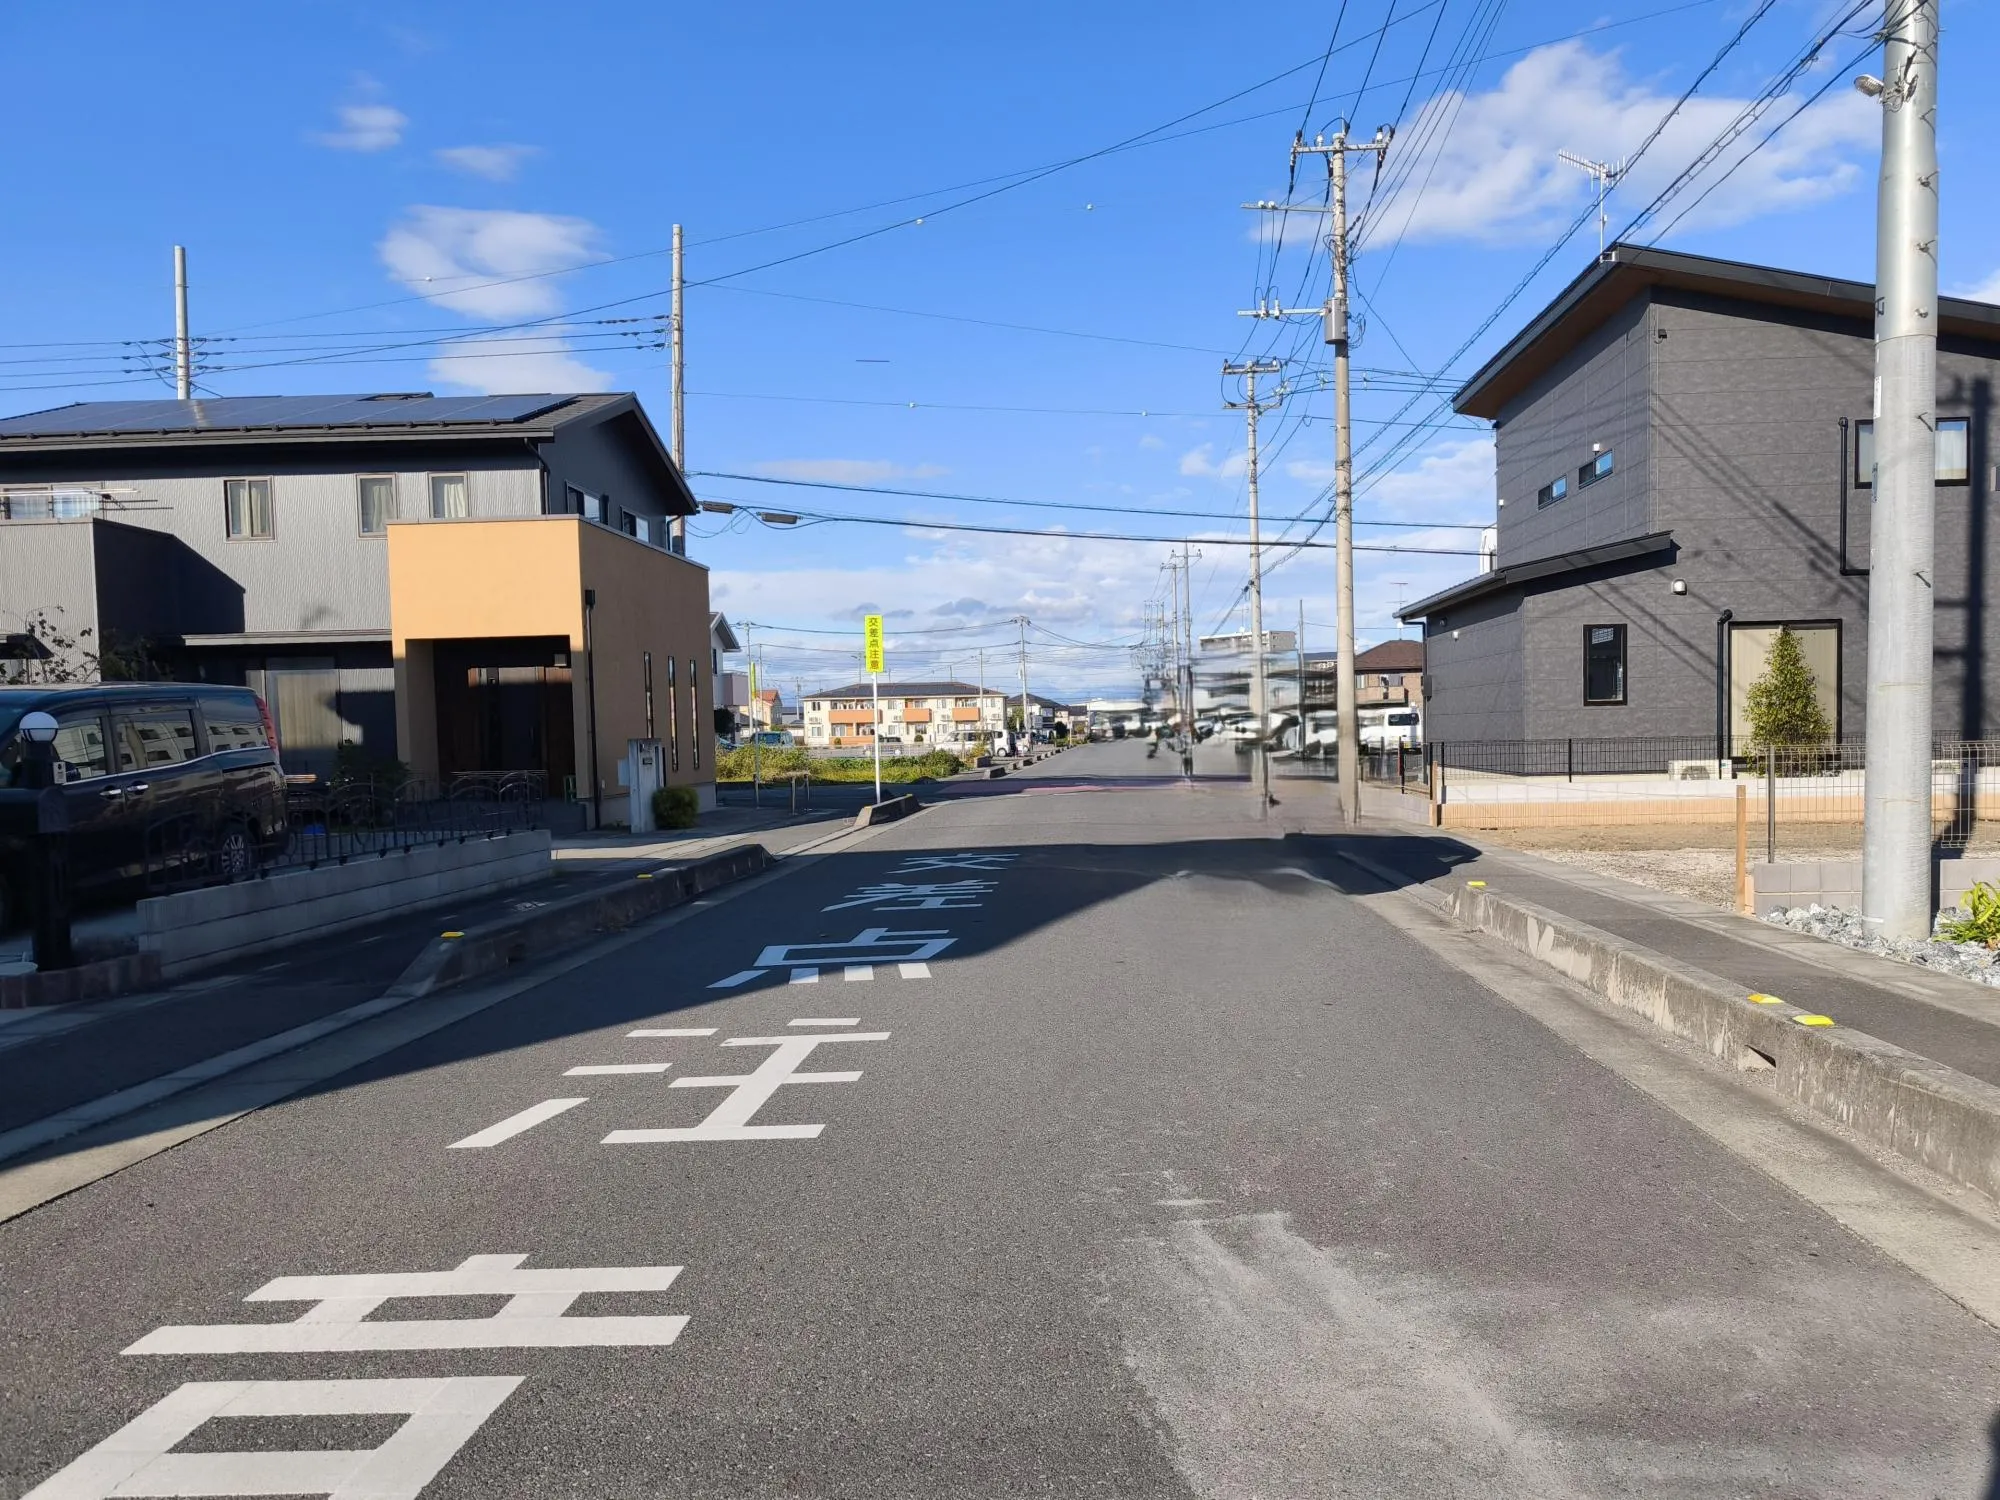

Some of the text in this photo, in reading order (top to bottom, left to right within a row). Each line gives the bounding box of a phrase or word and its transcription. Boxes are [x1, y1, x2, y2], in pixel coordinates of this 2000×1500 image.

[868, 617, 880, 670] 交差点注意
